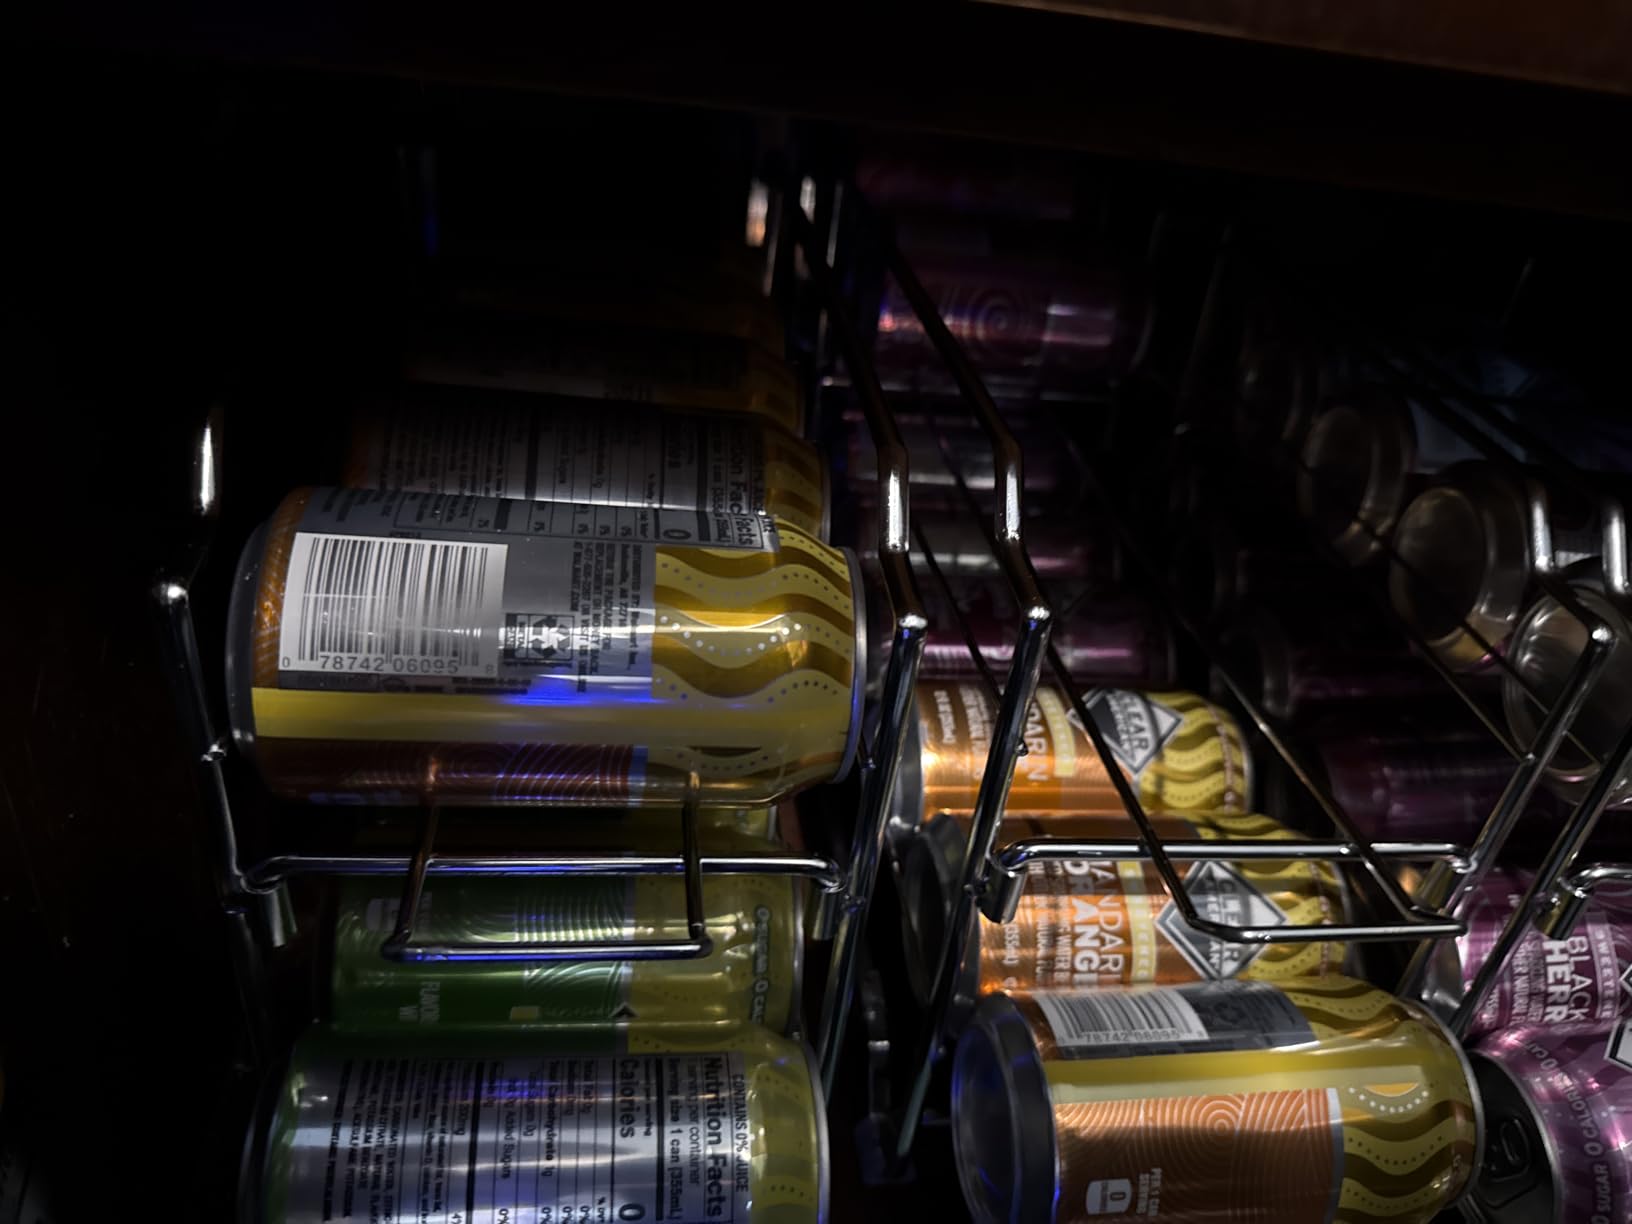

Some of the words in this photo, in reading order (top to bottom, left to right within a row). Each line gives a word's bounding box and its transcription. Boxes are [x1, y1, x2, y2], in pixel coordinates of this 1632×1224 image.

[729, 482, 748, 514] Fac
[663, 529, 691, 540] 0
[735, 518, 756, 545] Facts
[591, 614, 600, 645] MONEY
[282, 656, 290, 668] 0
[319, 654, 384, 671] 78742
[392, 658, 459, 674] 06095
[1121, 695, 1149, 750] CLEAR
[1089, 861, 1125, 984] ANDARI
[1206, 879, 1221, 962] AMERAN
[1220, 879, 1240, 962] CLER
[755, 922, 768, 974] SUGAR
[1054, 935, 1071, 970] WATER
[1542, 939, 1571, 1024] HERR
[1566, 935, 1593, 1021] BLACK
[419, 982, 440, 1024] FLAVOR
[1084, 1031, 1129, 1044] 78742
[667, 1058, 681, 1095] Serving
[620, 1058, 640, 1138] Calories
[671, 1099, 682, 1122] size
[686, 1105, 700, 1124] per
[704, 1057, 726, 1145] Nutrition
[732, 1074, 748, 1130] CONTAINS
[388, 1106, 402, 1158] CARBONATED
[503, 1111, 514, 1140] Added
[523, 1124, 536, 1136] 0g
[545, 1086, 558, 1161] Carbohydrate
[671, 1139, 681, 1163] can
[689, 1127, 702, 1184] container
[736, 1133, 748, 1152] 0%
[1584, 1142, 1602, 1156] 0
[502, 1144, 514, 1179] Sugars
[542, 1167, 554, 1177] 1g
[735, 1156, 749, 1192] JUICE
[667, 1167, 683, 1220] (355mL)
[707, 1154, 726, 1217] Facts
[1110, 1192, 1126, 1201] 0
[1594, 1163, 1611, 1212] SUGAR
[619, 1203, 645, 1221] 0
